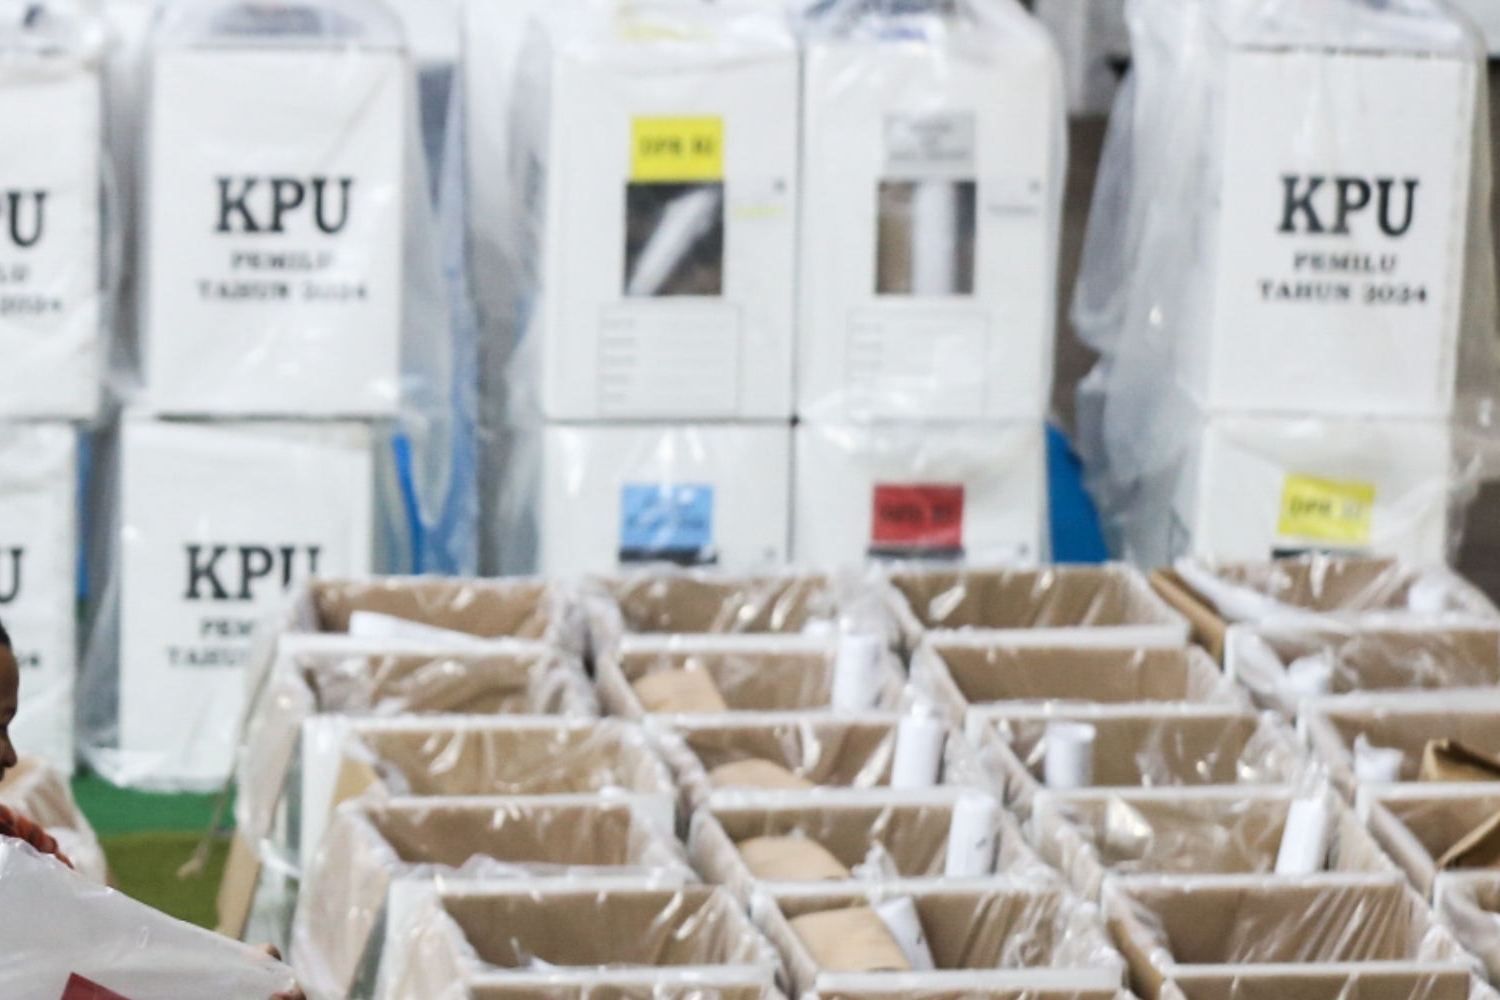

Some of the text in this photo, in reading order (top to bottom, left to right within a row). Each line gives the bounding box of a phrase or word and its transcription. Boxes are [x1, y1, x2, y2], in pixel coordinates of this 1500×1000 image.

[216, 177, 353, 233] KPU
[1278, 176, 1420, 237] KPU
[1294, 253, 1397, 272] PEMILU
[1258, 280, 1429, 305] TAHUN 2024
[184, 546, 320, 600] KPU
